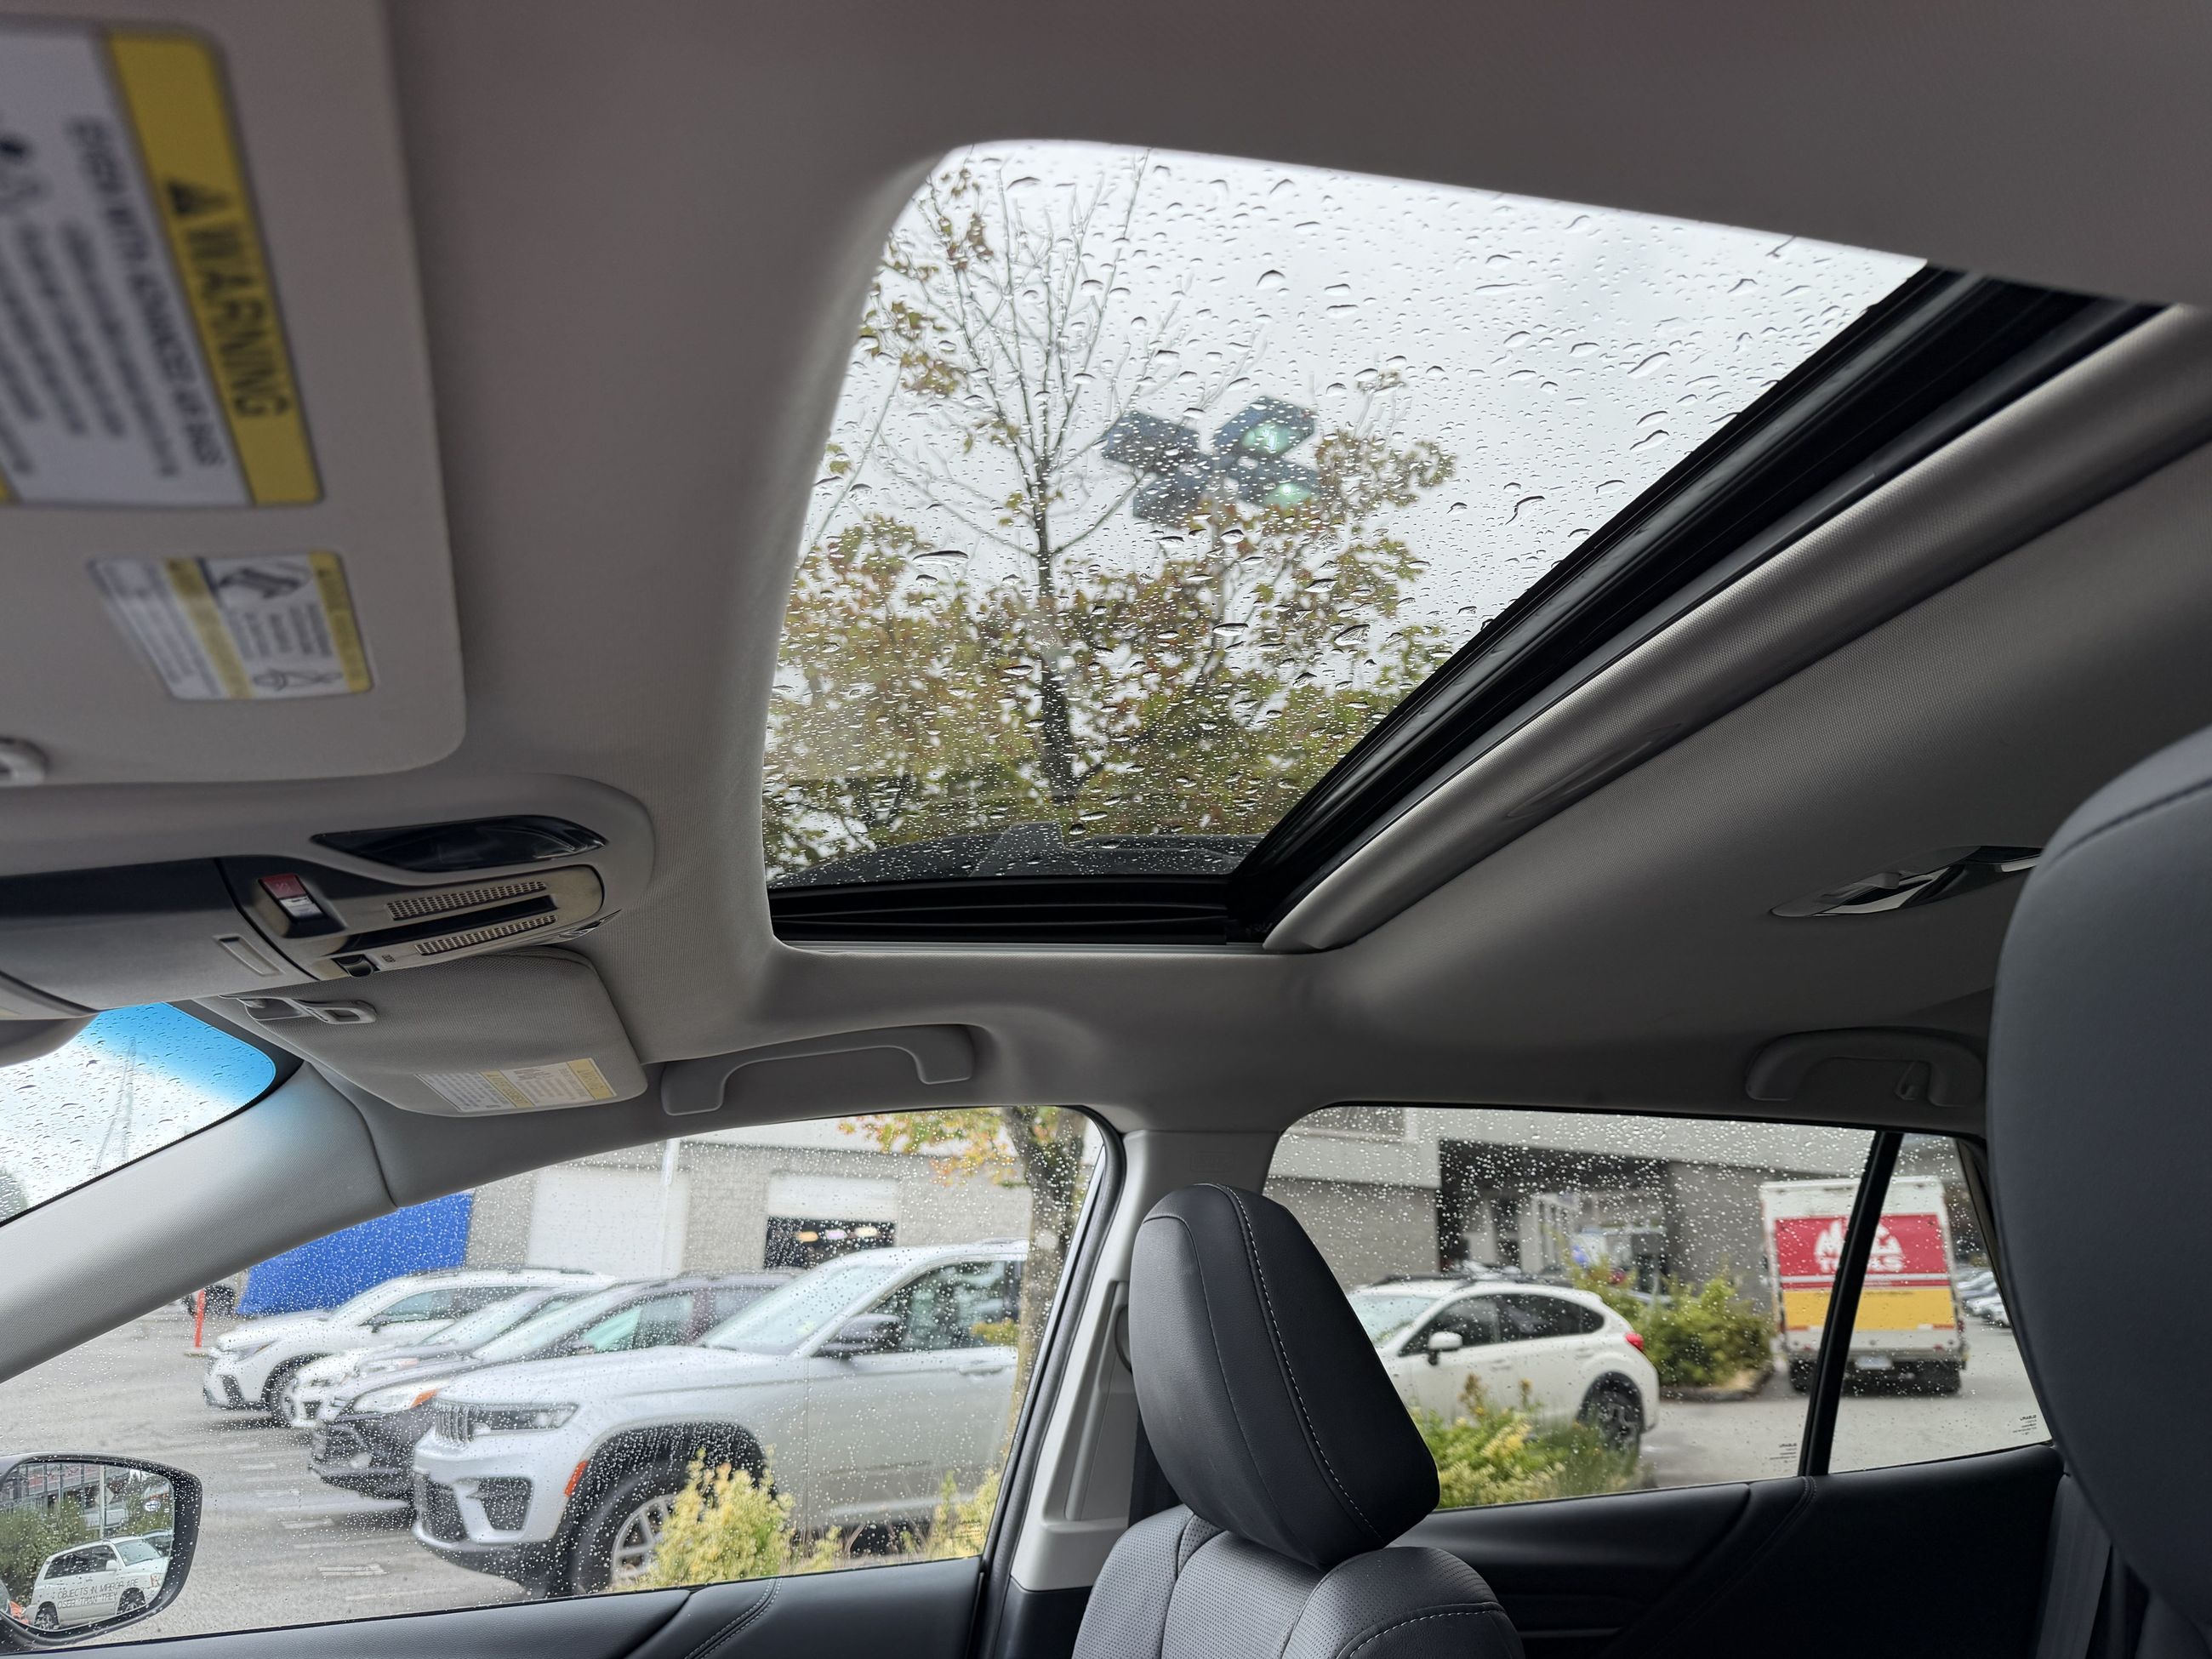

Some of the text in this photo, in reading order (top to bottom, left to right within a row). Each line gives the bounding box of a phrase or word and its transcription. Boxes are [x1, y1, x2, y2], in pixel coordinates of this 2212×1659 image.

[185, 223, 290, 418] WARNING
[57, 1587, 88, 1599] OBJECTS
[127, 1578, 139, 1588] ARE
